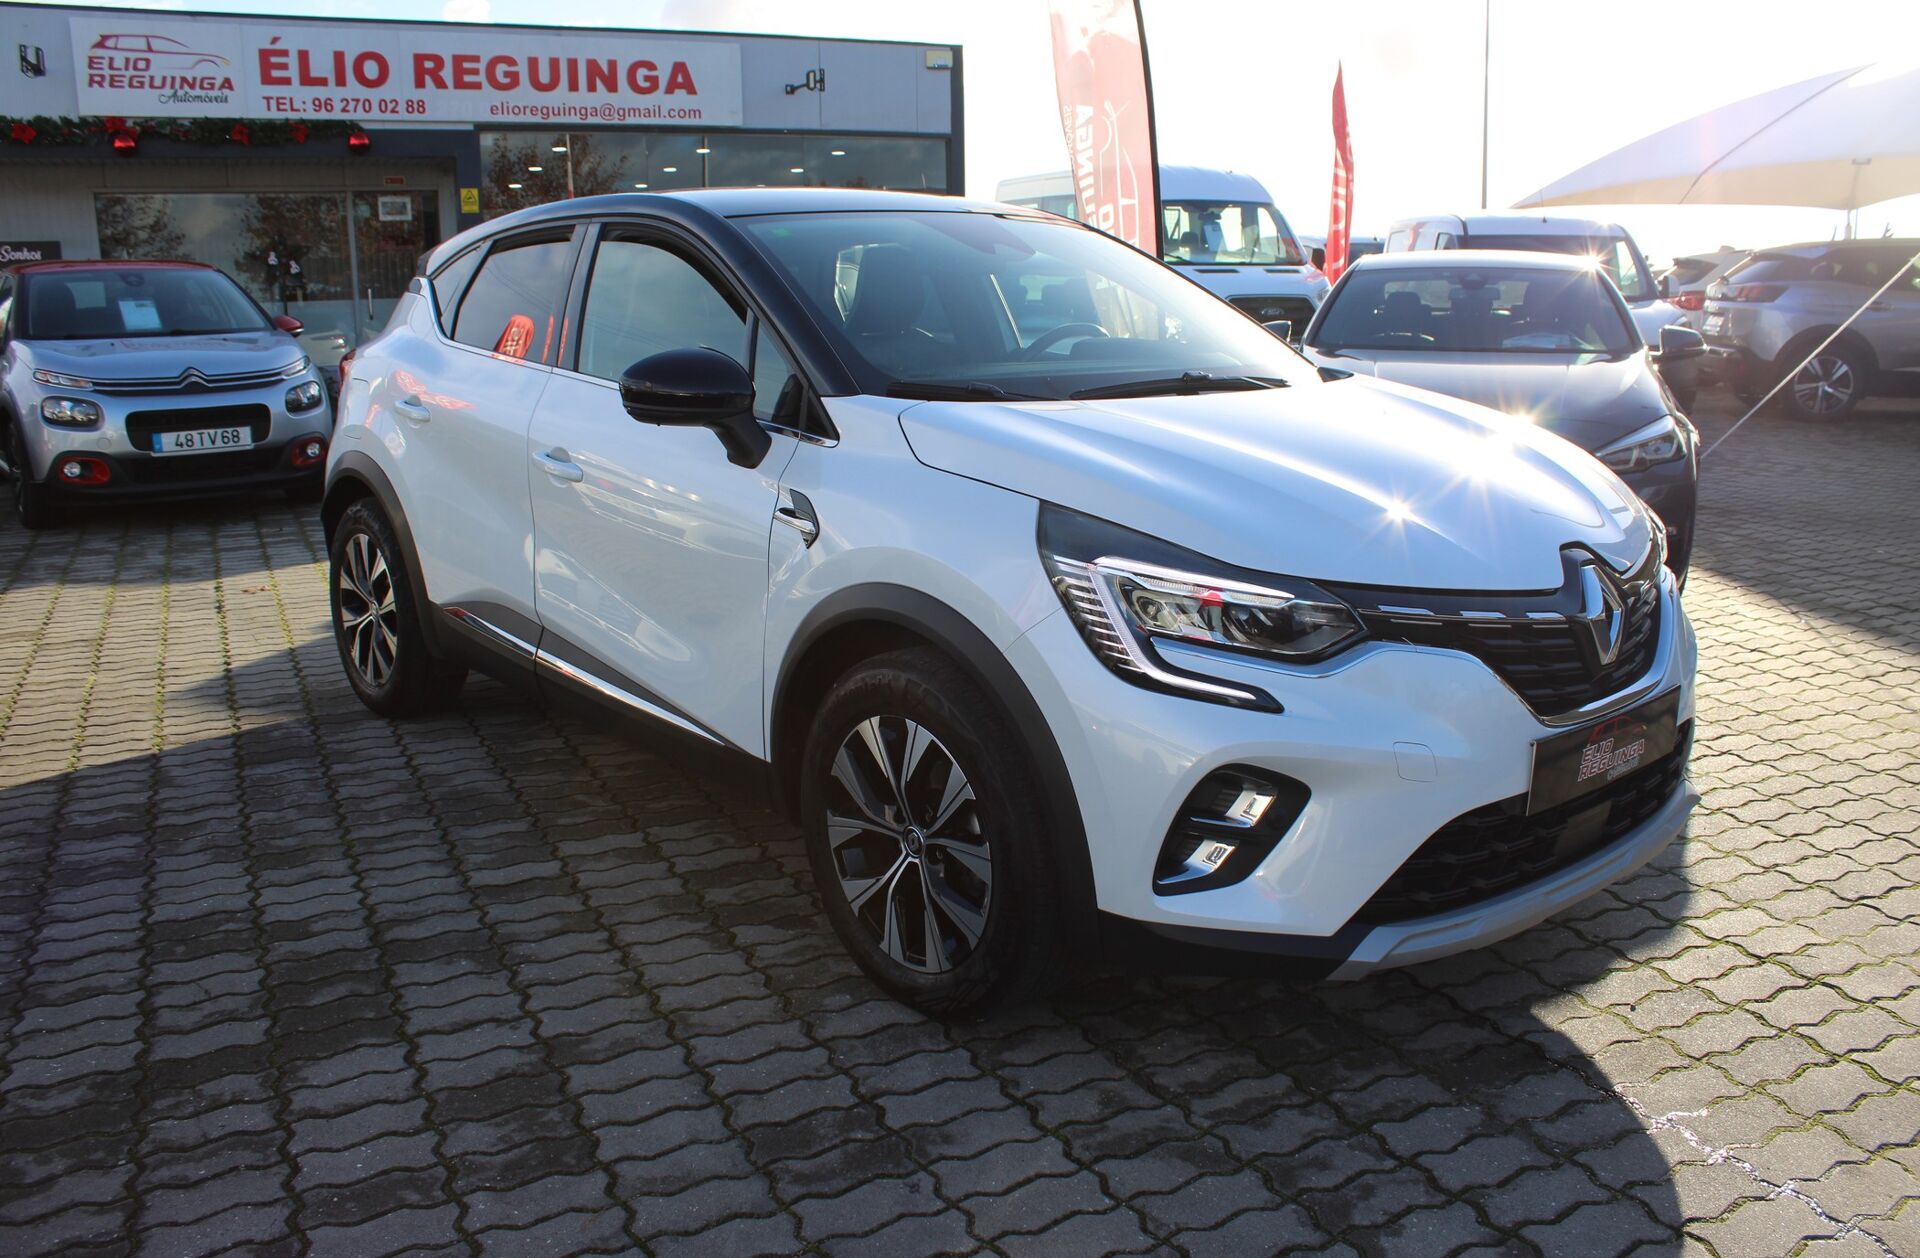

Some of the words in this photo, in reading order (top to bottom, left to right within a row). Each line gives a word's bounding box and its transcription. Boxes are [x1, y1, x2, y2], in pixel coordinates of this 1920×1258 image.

[258, 36, 390, 88] ÉLIO
[412, 52, 698, 96] REGUINGA
[87, 74, 235, 92] REGUINGA
[262, 96, 308, 113] TEL:
[311, 97, 334, 114] 96
[340, 98, 372, 114] 270
[378, 99, 400, 115] 02
[405, 100, 426, 115] 88
[489, 102, 702, 121] elioreguinga@gmail.com
[1577, 739, 1645, 782] REGUINGA
